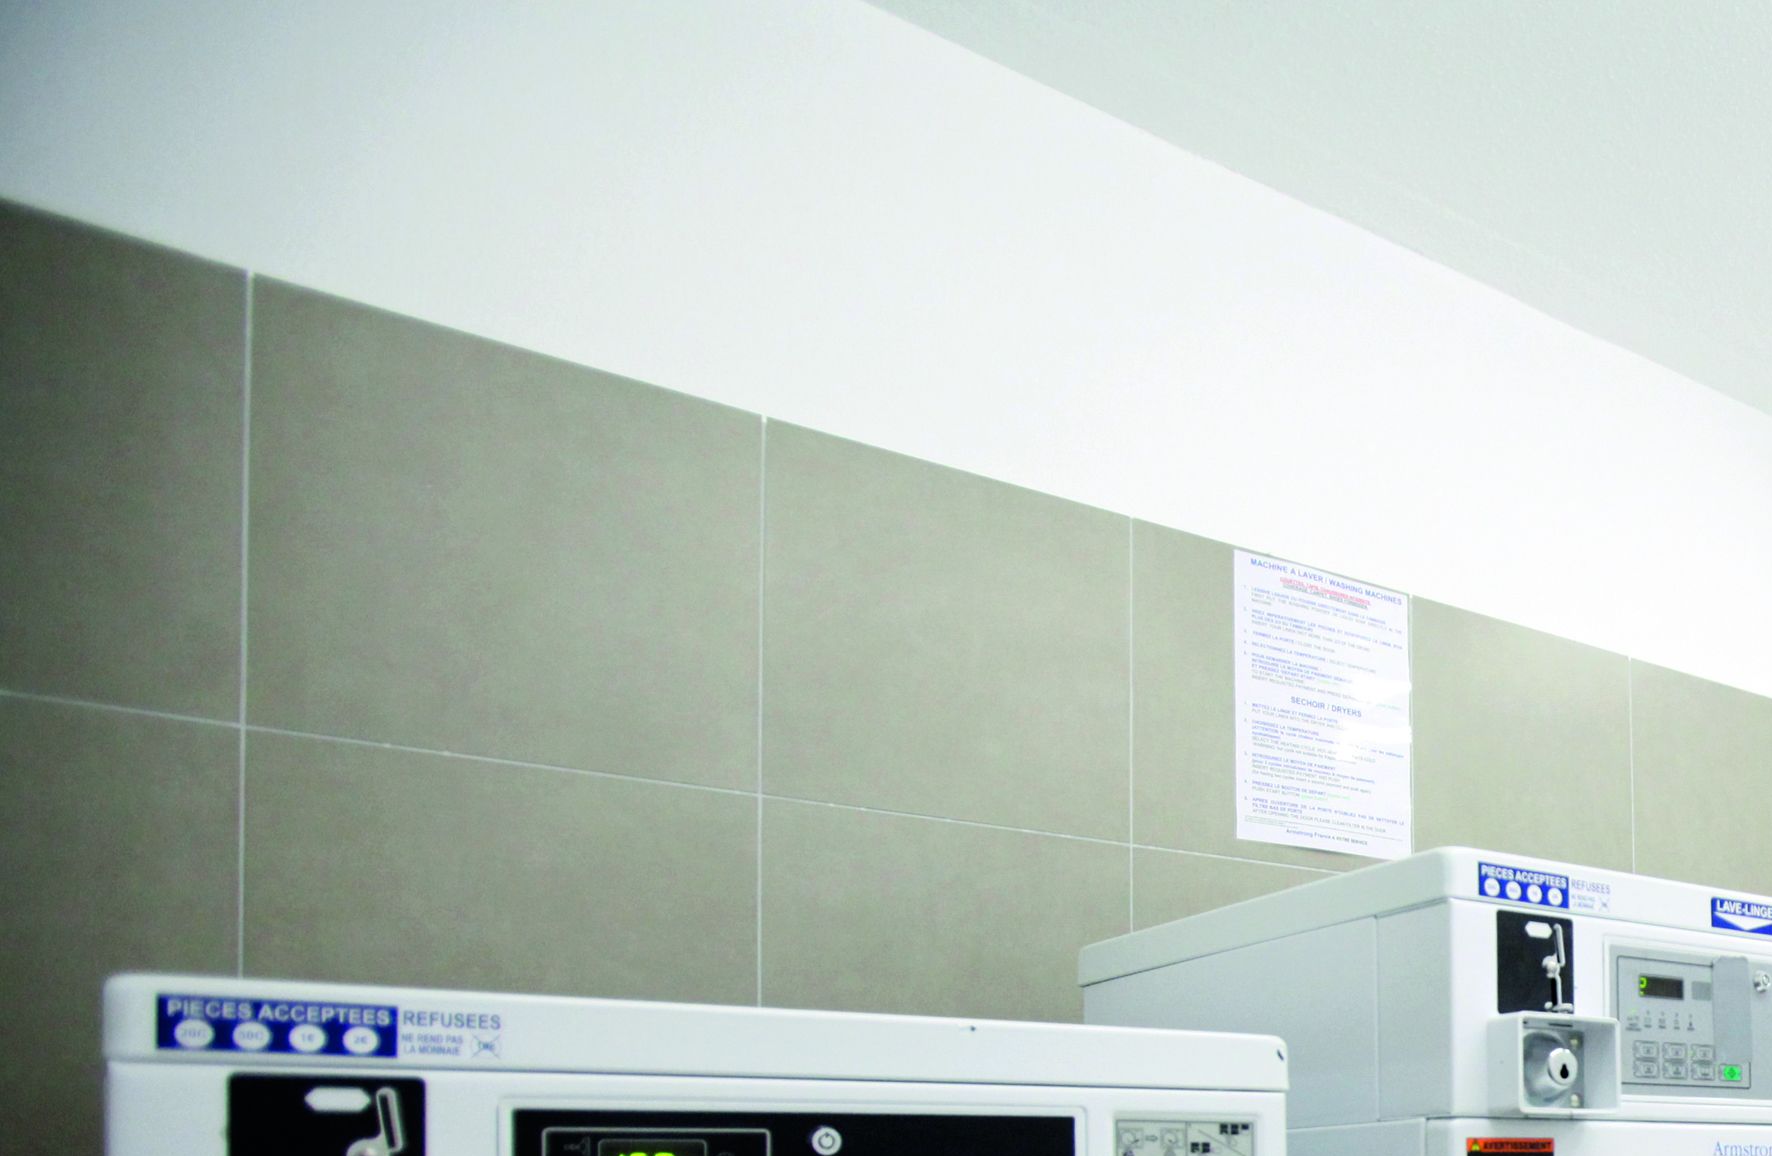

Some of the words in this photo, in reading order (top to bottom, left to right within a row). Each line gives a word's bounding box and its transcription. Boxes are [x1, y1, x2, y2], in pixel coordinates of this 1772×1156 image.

[1250, 558, 1288, 575] MACHINE
[1290, 568, 1296, 577] A
[1298, 570, 1323, 584] LAVER
[1328, 578, 1362, 594] WASHING
[1364, 588, 1402, 605] MACHINES
[1290, 696, 1325, 710] SECHOIR
[1331, 704, 1362, 718] DRYERS
[1481, 864, 1514, 880] PIECES
[1515, 868, 1567, 888] ACCEPTEES
[1571, 879, 1610, 895] REFUSEES
[166, 999, 252, 1020] PIECES
[258, 1004, 390, 1026] ACCEPTEES
[403, 1010, 501, 1030] REFUSEES
[402, 1033, 414, 1042] NE
[417, 1034, 443, 1044] REND
[446, 1035, 463, 1045] PAS
[404, 1046, 416, 1054] LA
[419, 1046, 460, 1056] MONNAIE
[1483, 1141, 1552, 1150] AVERTISSEMENT
